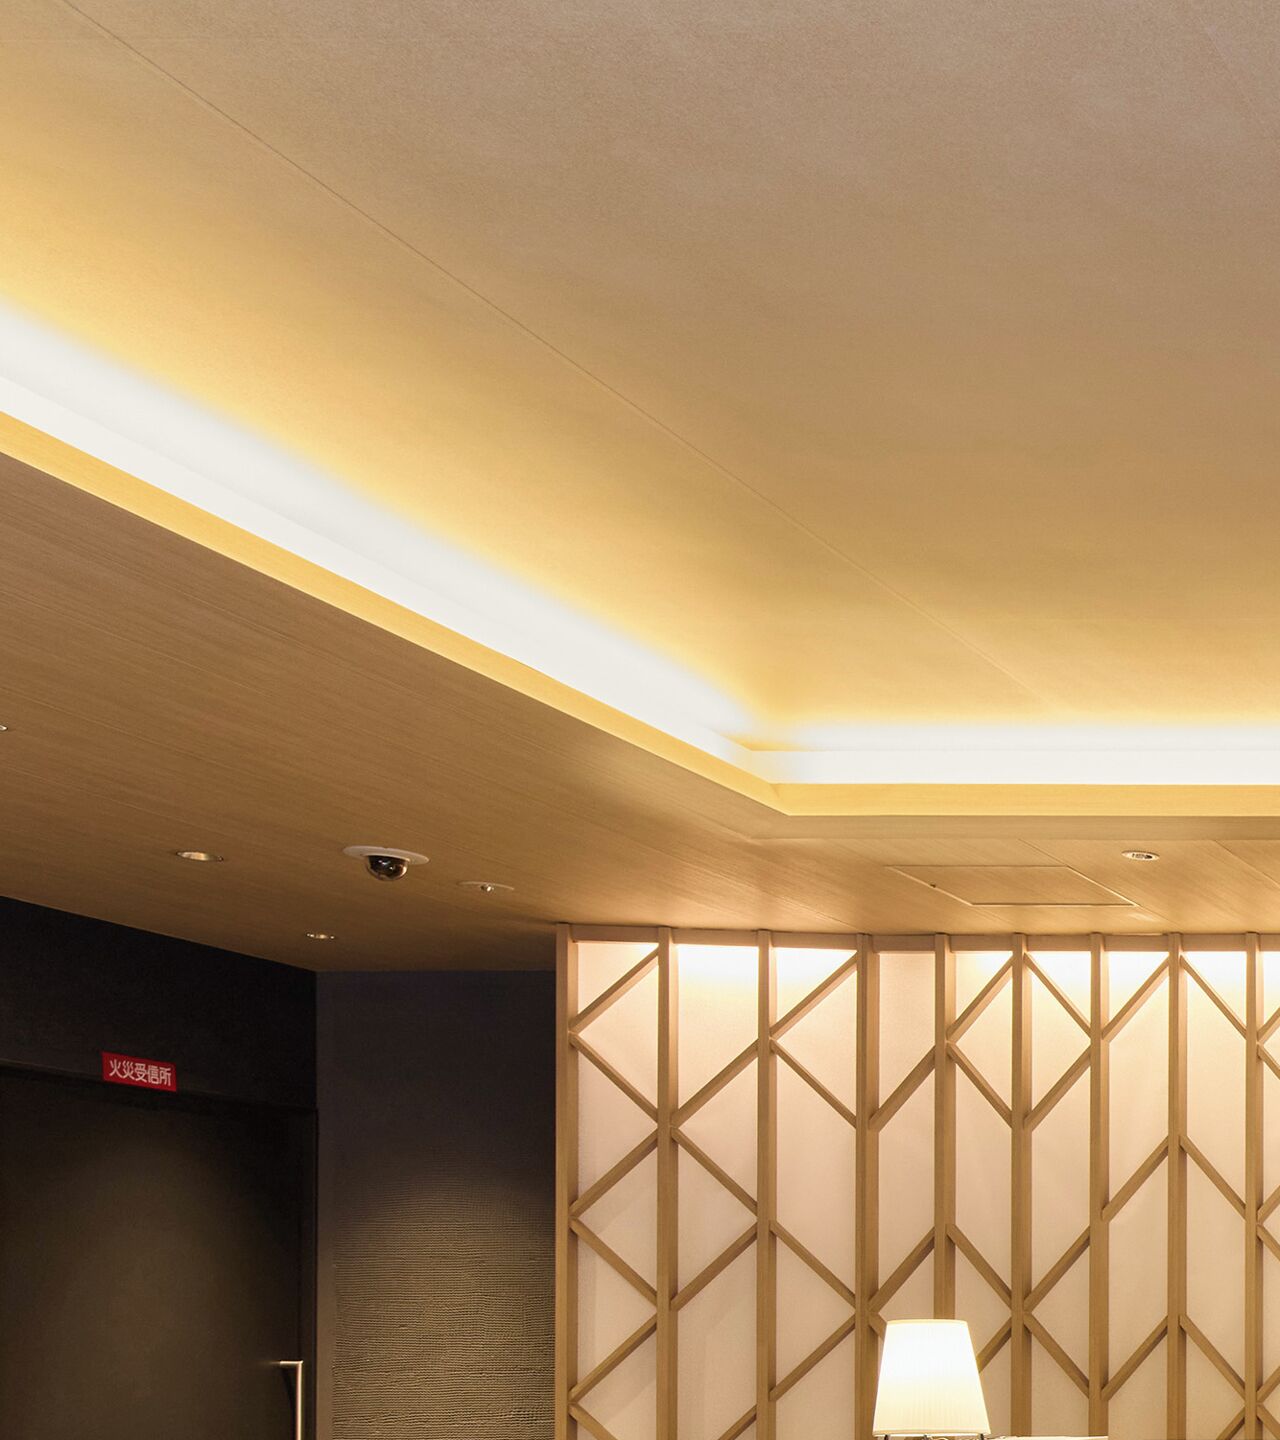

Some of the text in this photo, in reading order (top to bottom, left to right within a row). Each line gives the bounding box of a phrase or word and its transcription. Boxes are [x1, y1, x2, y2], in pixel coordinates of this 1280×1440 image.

[109, 1059, 171, 1086] 火災受信所
